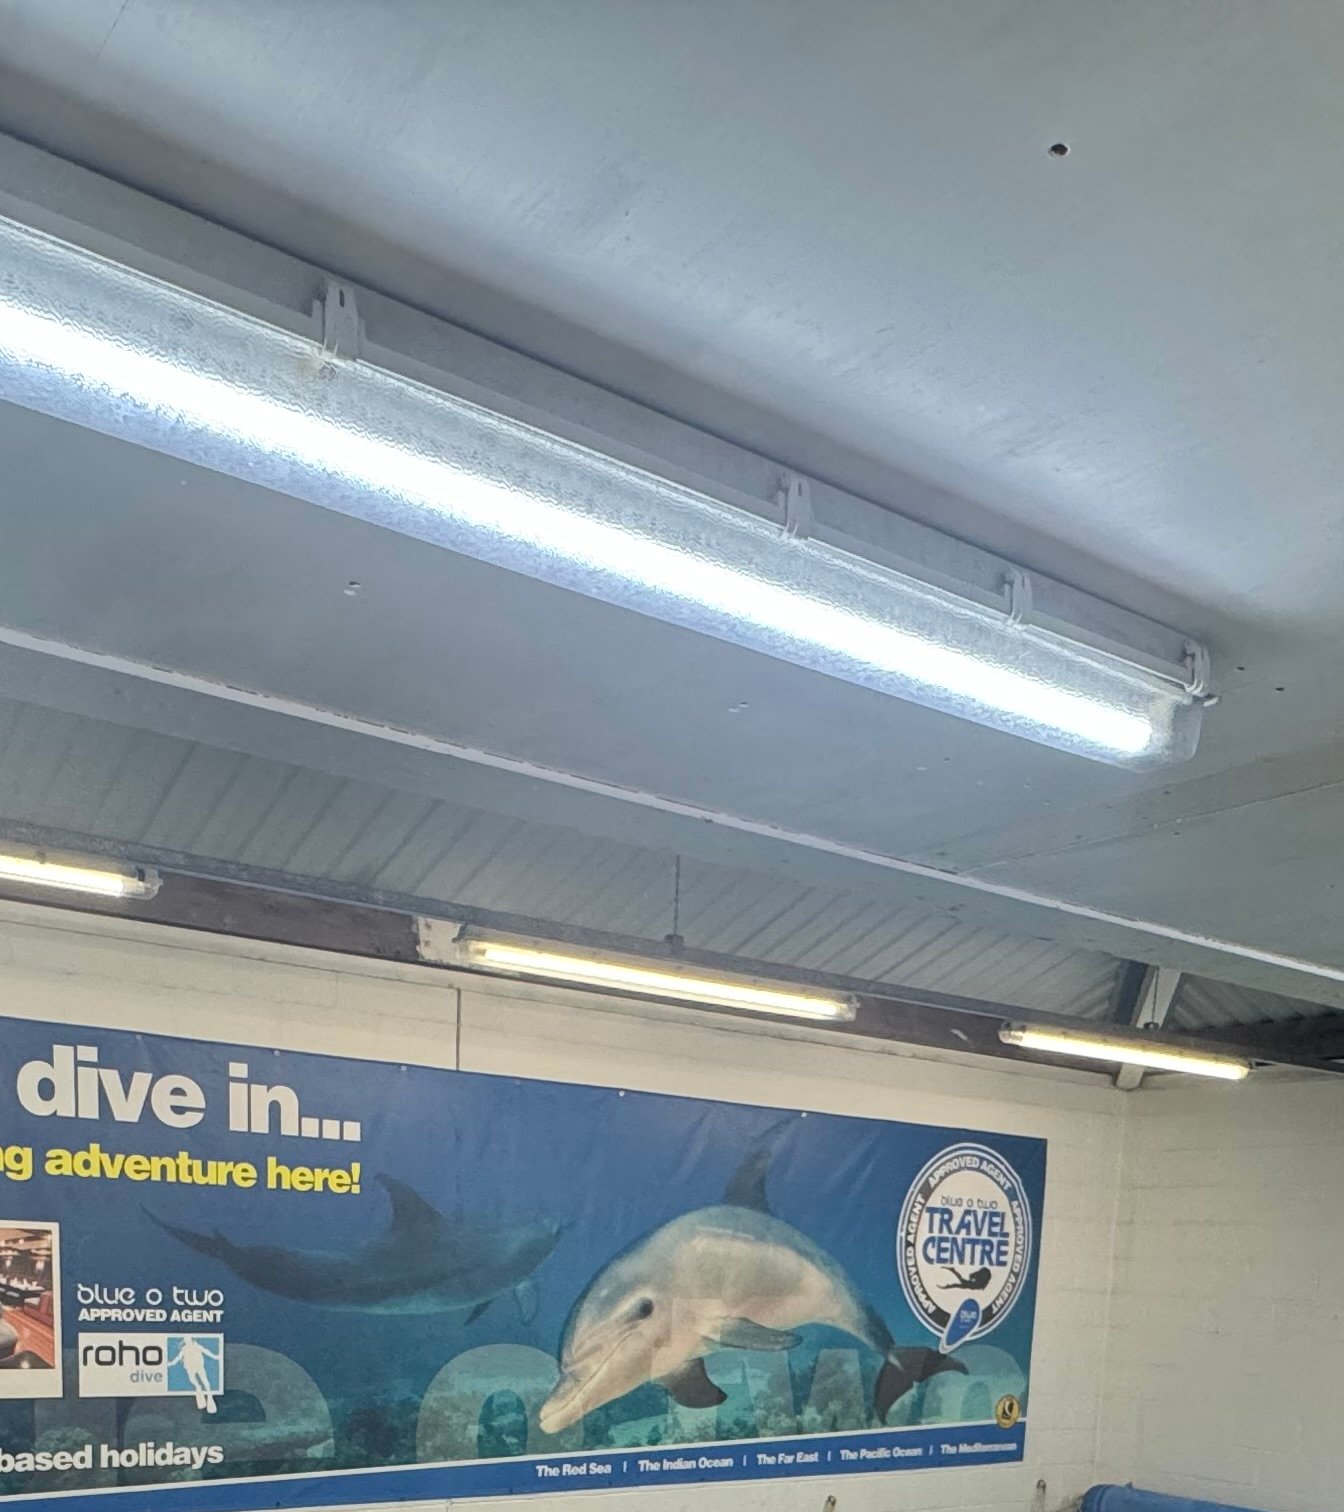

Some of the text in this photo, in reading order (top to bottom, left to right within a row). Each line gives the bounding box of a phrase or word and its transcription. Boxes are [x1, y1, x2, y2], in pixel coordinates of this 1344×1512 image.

[17, 1044, 206, 1128] dive
[228, 1062, 361, 1141] in...
[45, 1143, 257, 1187] adventure
[267, 1157, 361, 1194] here!
[929, 1156, 1011, 1191] APPROVED AGENT
[907, 1193, 925, 1243] AGENT
[925, 1207, 1009, 1238] TRAVEL
[922, 1236, 1009, 1267] CENTRE
[77, 1283, 224, 1307] blue o two
[991, 1274, 1017, 1314] AGENT
[78, 1308, 224, 1323] APPROVED AGENT
[83, 1340, 163, 1366] roho
[130, 1370, 163, 1383] dive
[100, 1442, 224, 1469] holidays
[757, 1452, 819, 1465] The Far East
[840, 1450, 858, 1460] The
[941, 1444, 957, 1455] The
[536, 1462, 612, 1477] The Red Sea
[638, 1456, 733, 1471] The Indian Ocean
